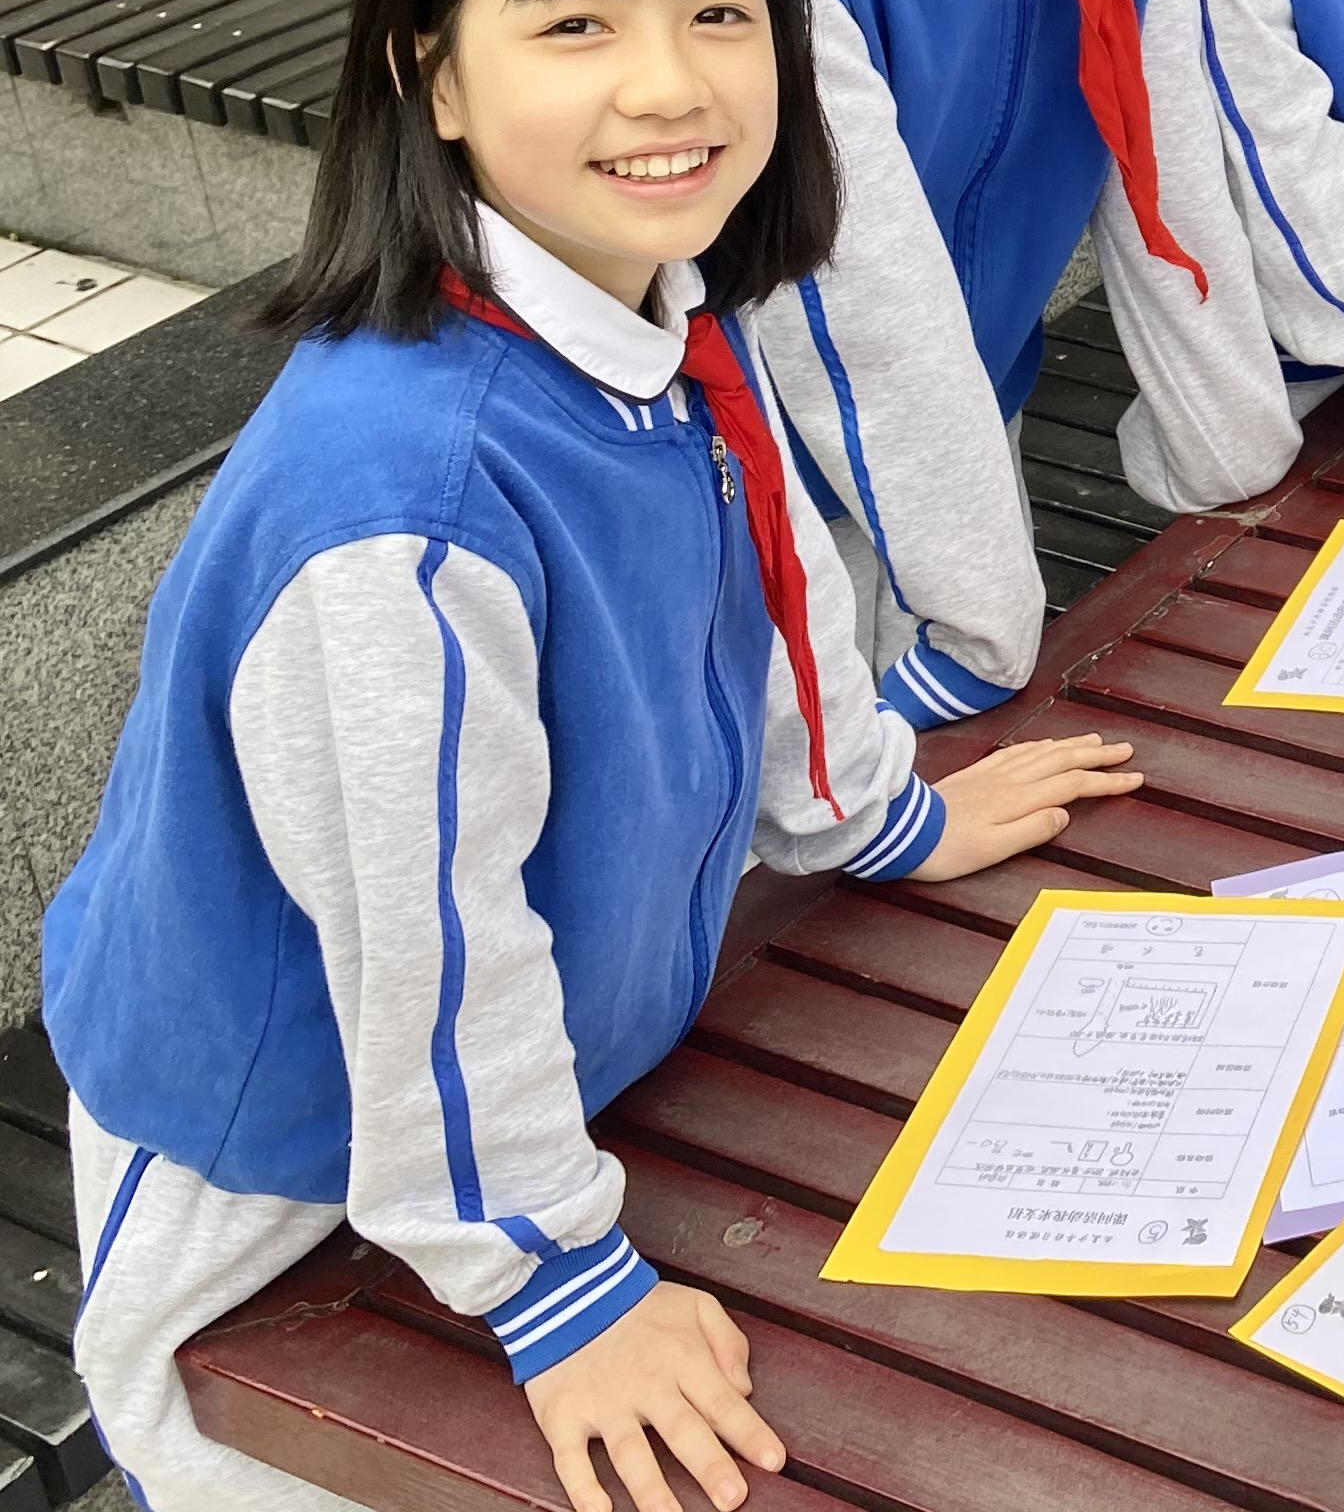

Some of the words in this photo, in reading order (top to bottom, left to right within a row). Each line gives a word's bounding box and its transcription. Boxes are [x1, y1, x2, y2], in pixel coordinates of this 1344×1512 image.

[1008, 1207, 1128, 1225] 课间活动我来支招
